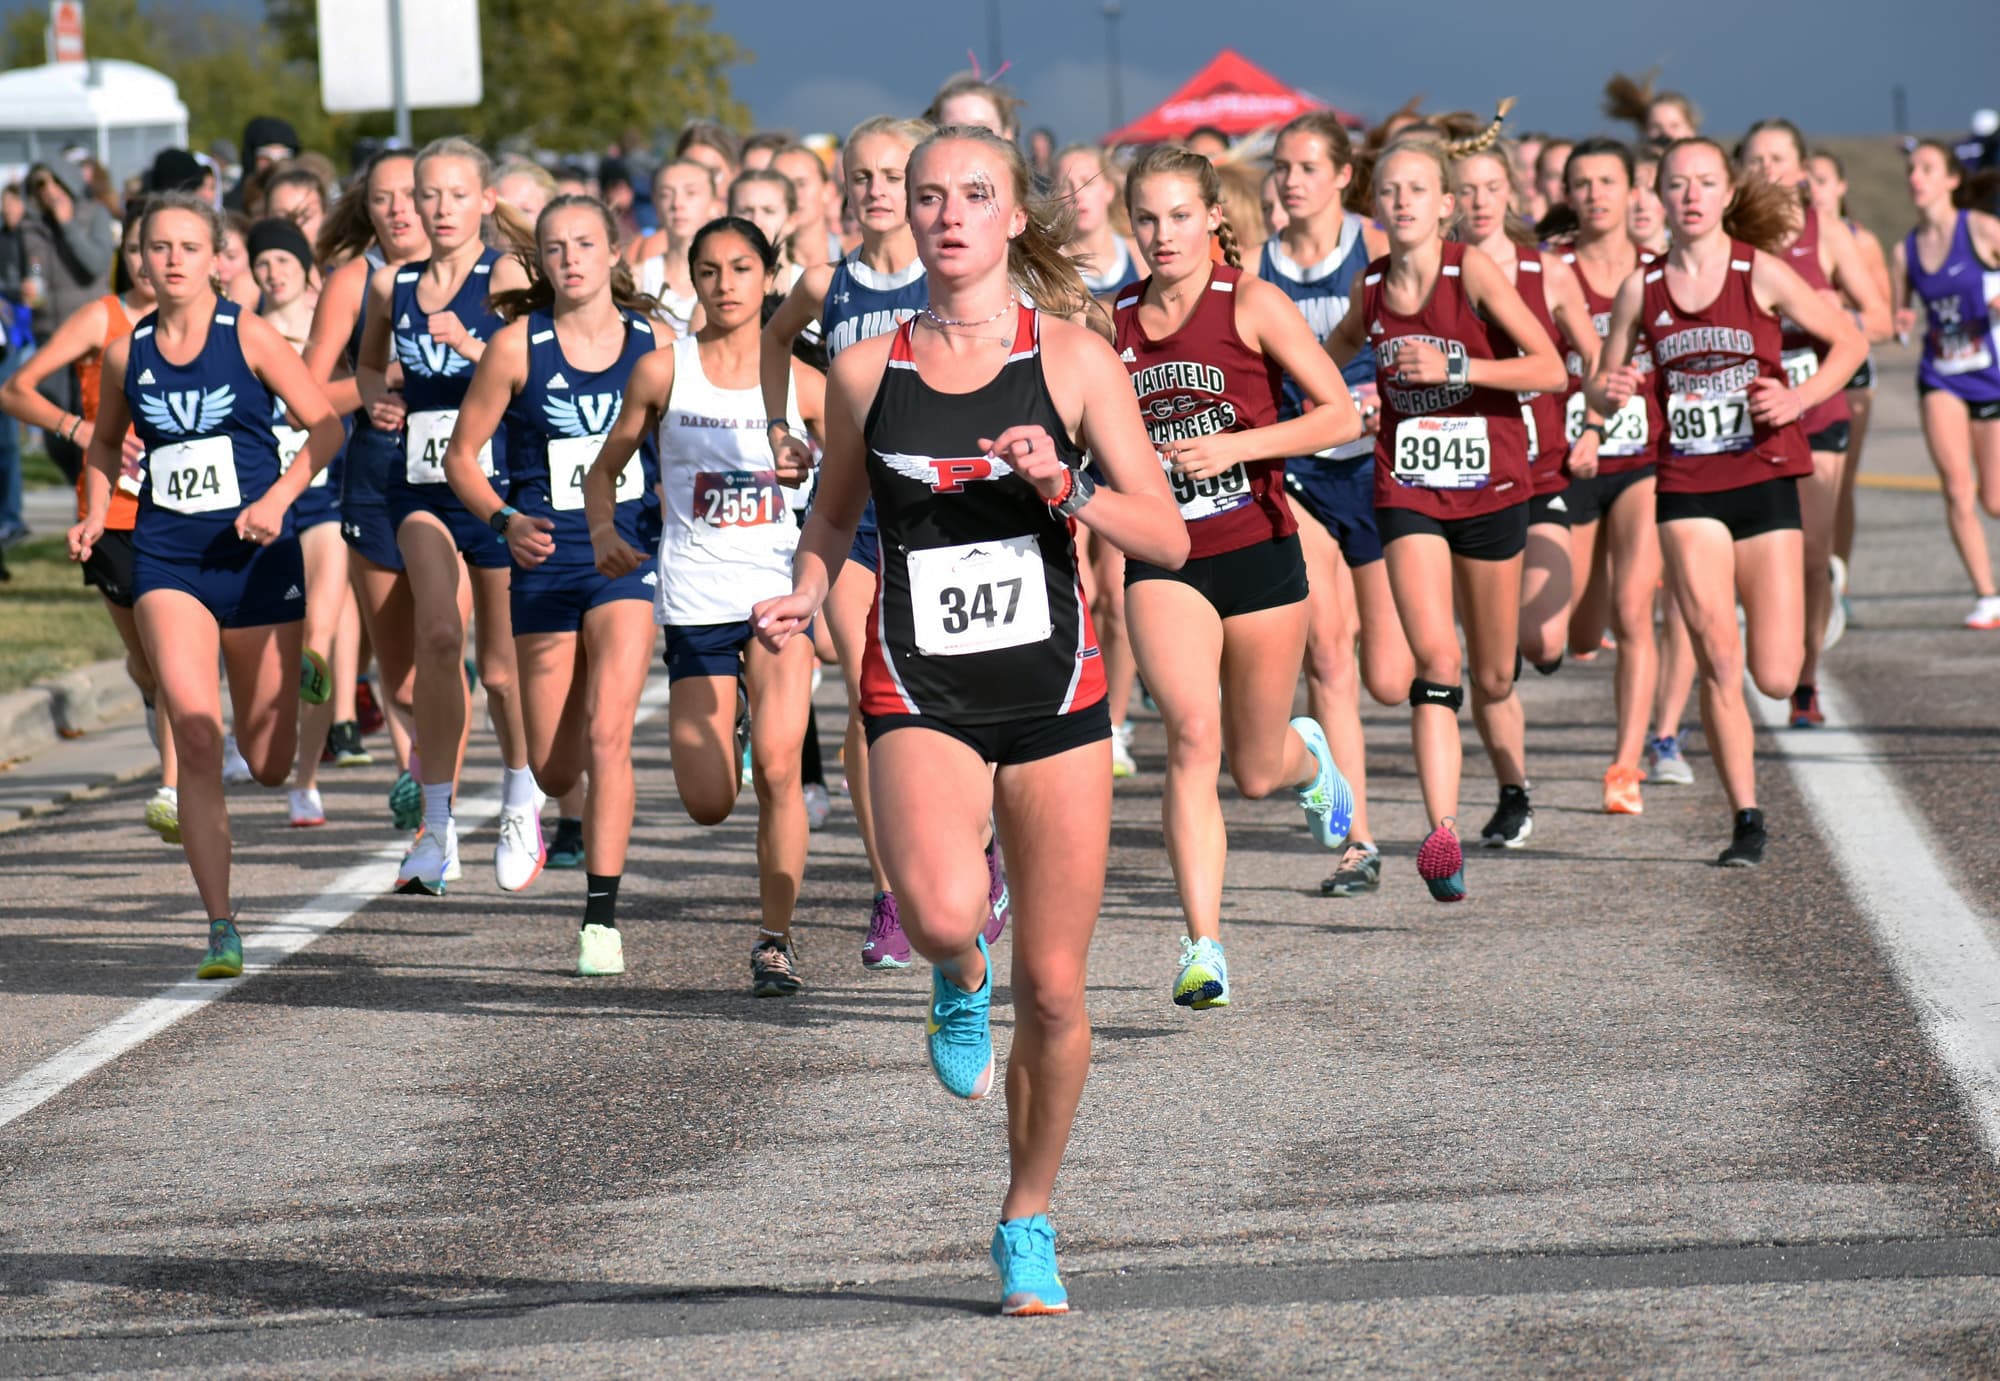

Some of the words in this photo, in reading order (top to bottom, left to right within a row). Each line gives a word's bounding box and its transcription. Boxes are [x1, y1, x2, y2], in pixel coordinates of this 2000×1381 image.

[418, 333, 447, 373] V
[1656, 326, 1755, 365] CHATFIELD
[168, 391, 200, 430] V
[578, 393, 613, 432] V
[680, 415, 738, 430] DAKOTA
[1672, 403, 1745, 440] 3917
[1401, 436, 1485, 470] 3945
[168, 464, 221, 501] 424
[929, 457, 992, 493] P
[704, 486, 774, 524] 2551
[939, 577, 1022, 634] 347
